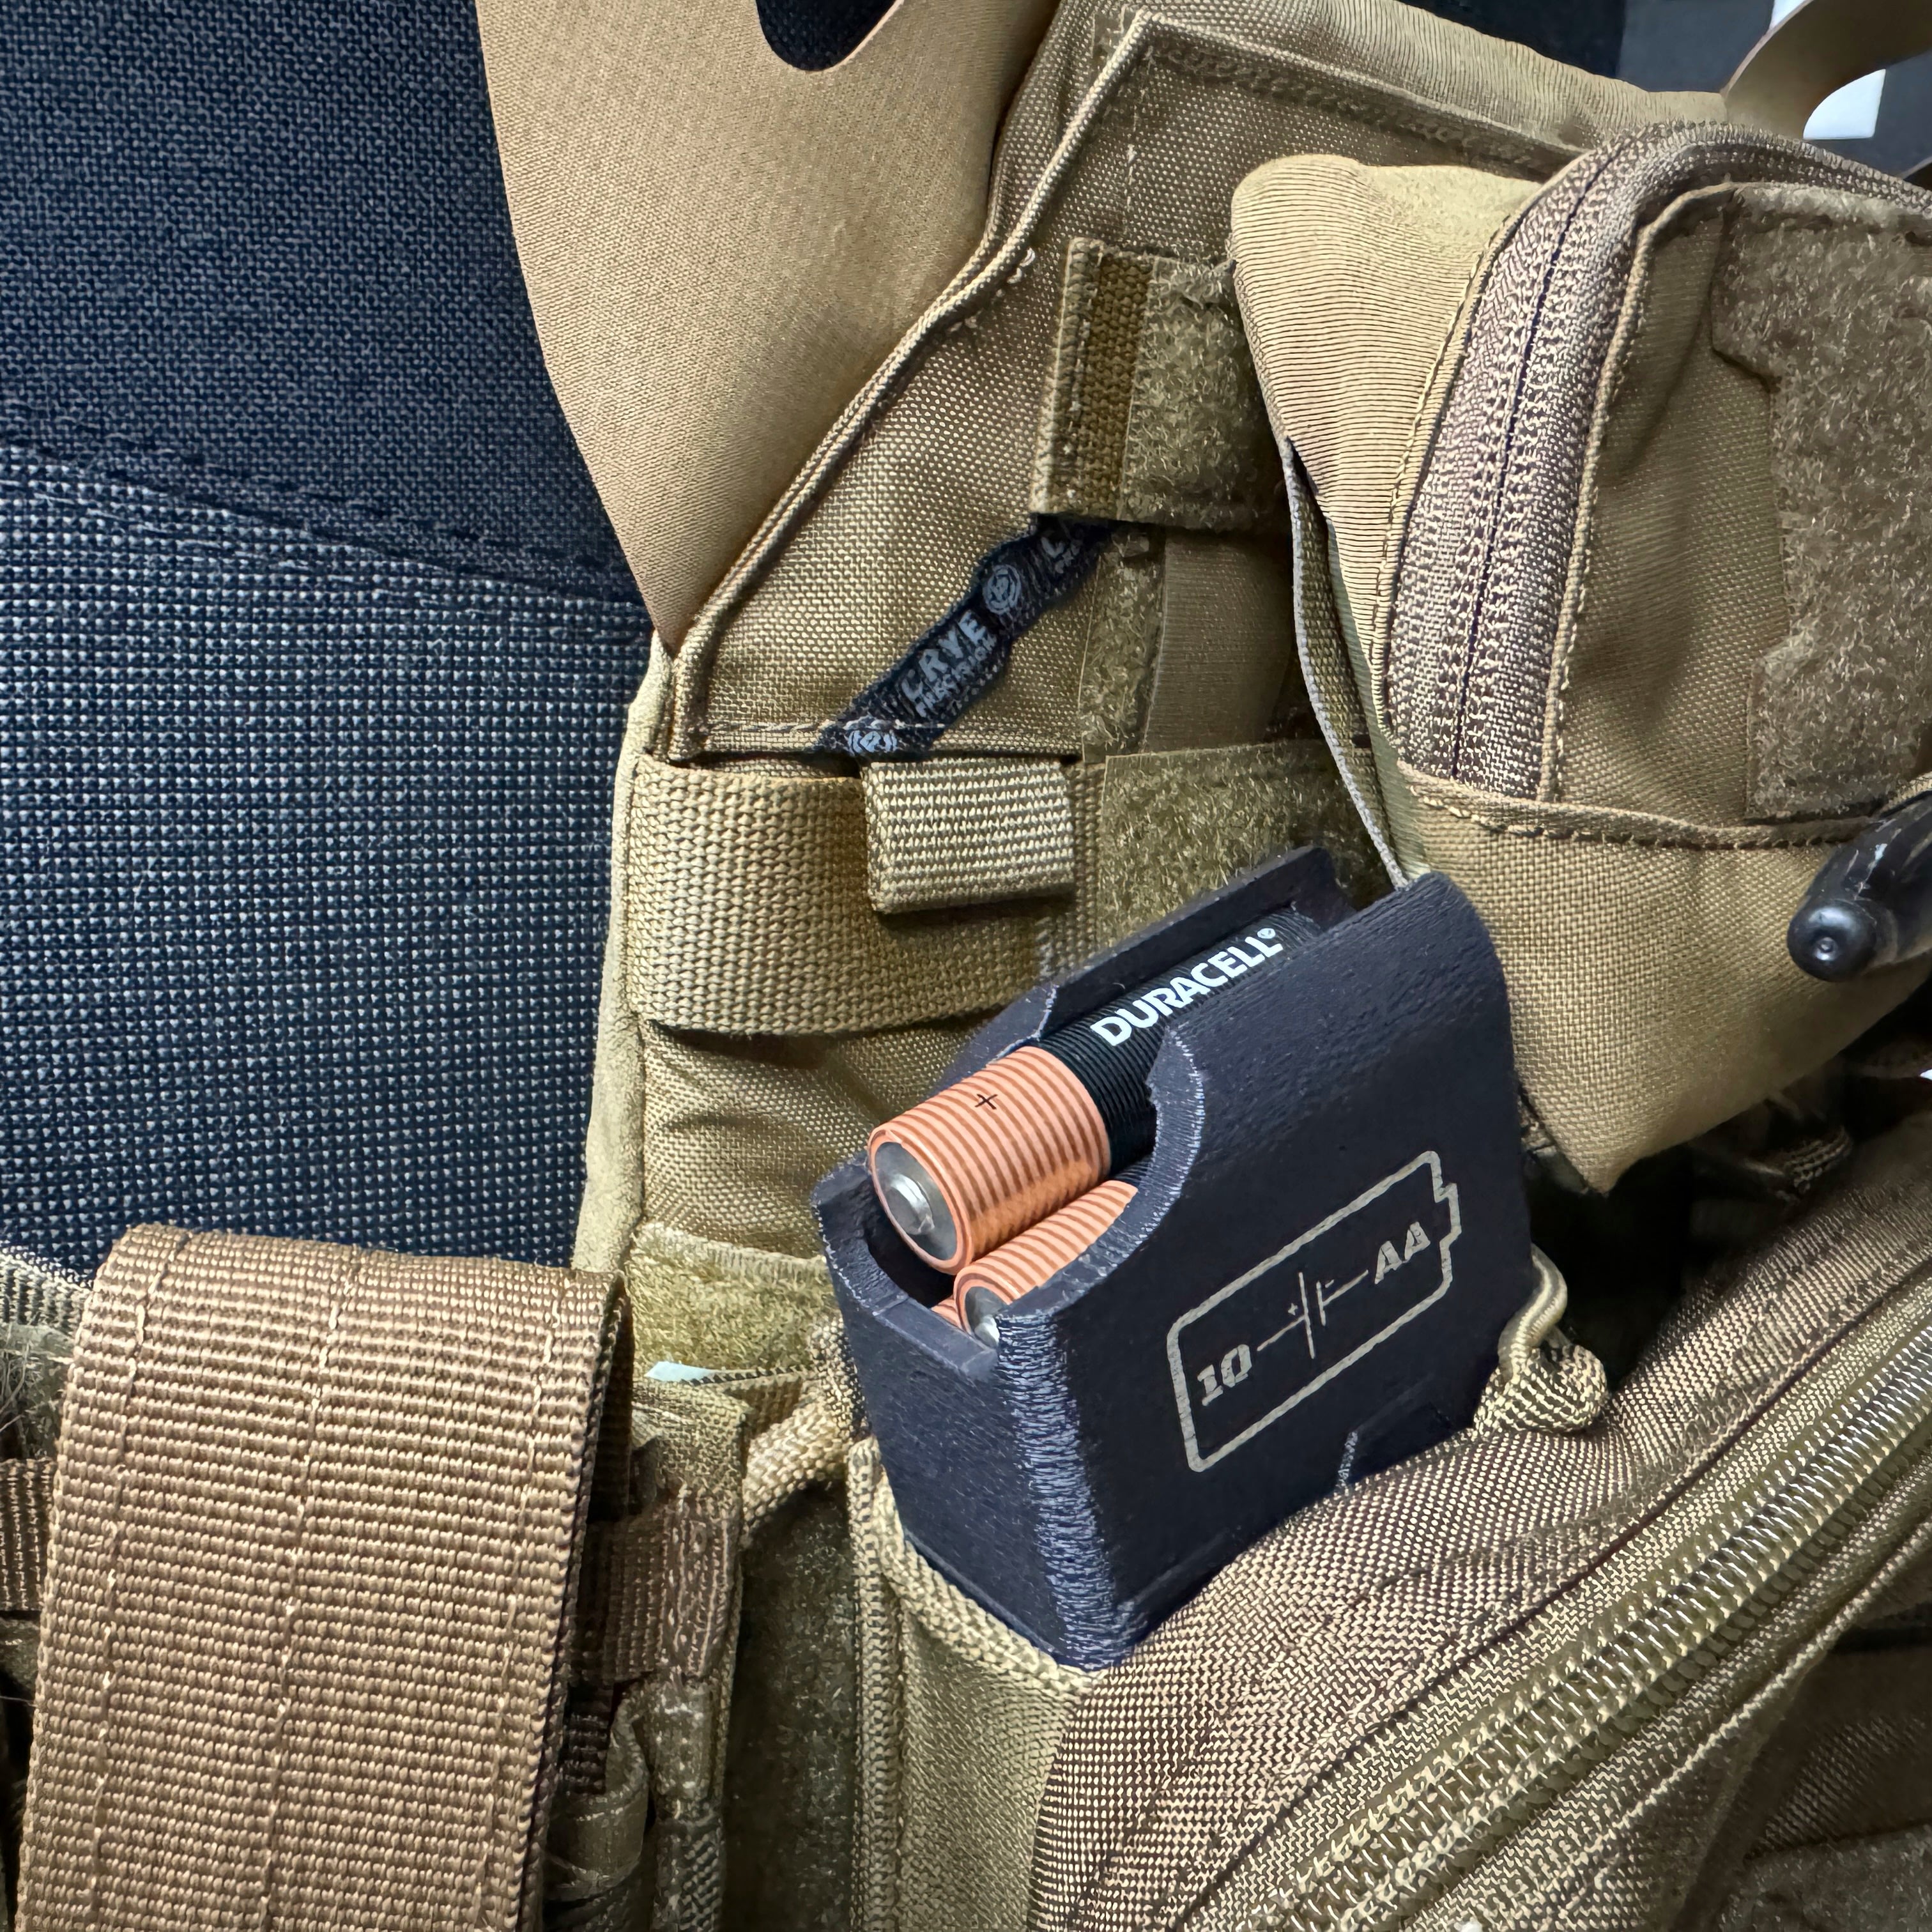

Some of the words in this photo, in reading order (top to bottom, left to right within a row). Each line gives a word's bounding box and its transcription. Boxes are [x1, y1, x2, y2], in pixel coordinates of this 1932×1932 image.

[901, 610, 990, 702] CRYE
[1197, 1344, 1253, 1407] 10
[1374, 1221, 1431, 1285] AA
